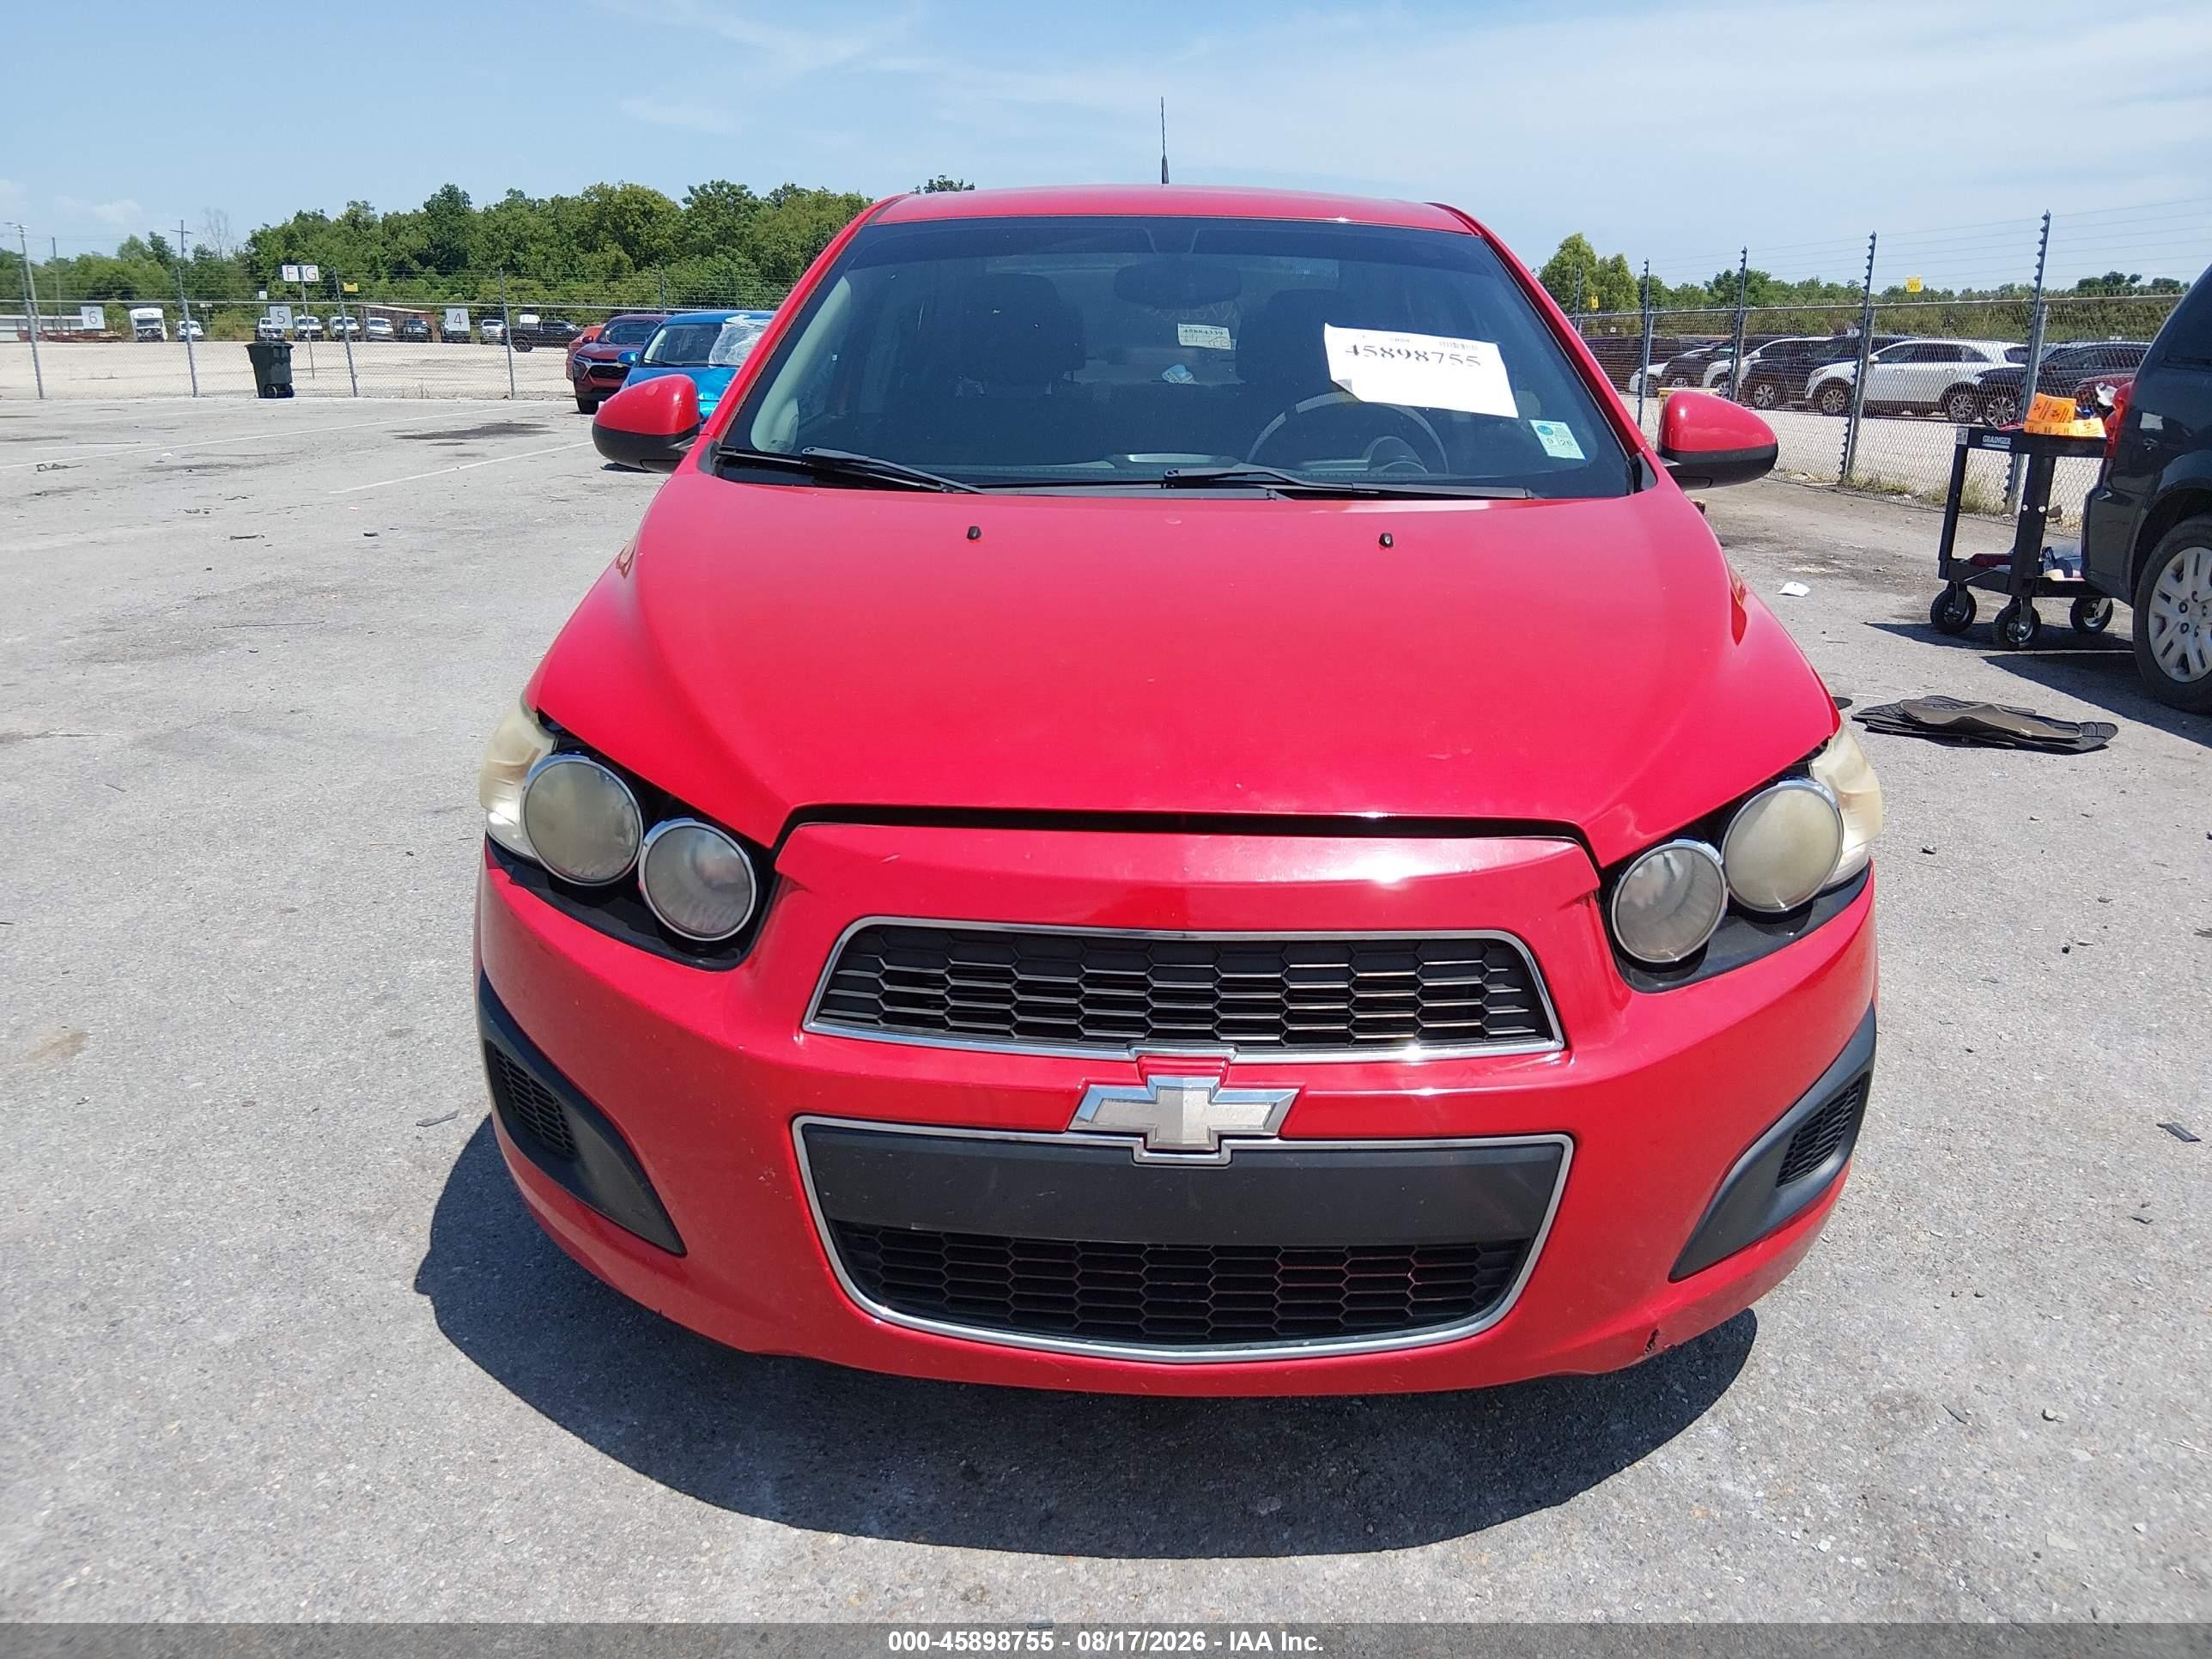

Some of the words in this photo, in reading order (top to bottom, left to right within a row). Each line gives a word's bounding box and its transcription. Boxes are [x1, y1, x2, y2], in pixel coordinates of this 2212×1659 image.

[285, 266, 294, 280] F
[305, 266, 317, 281] G
[88, 311, 98, 325] 6
[276, 310, 286, 325] 5
[453, 313, 463, 326] 4
[1345, 343, 1482, 368] 45898755
